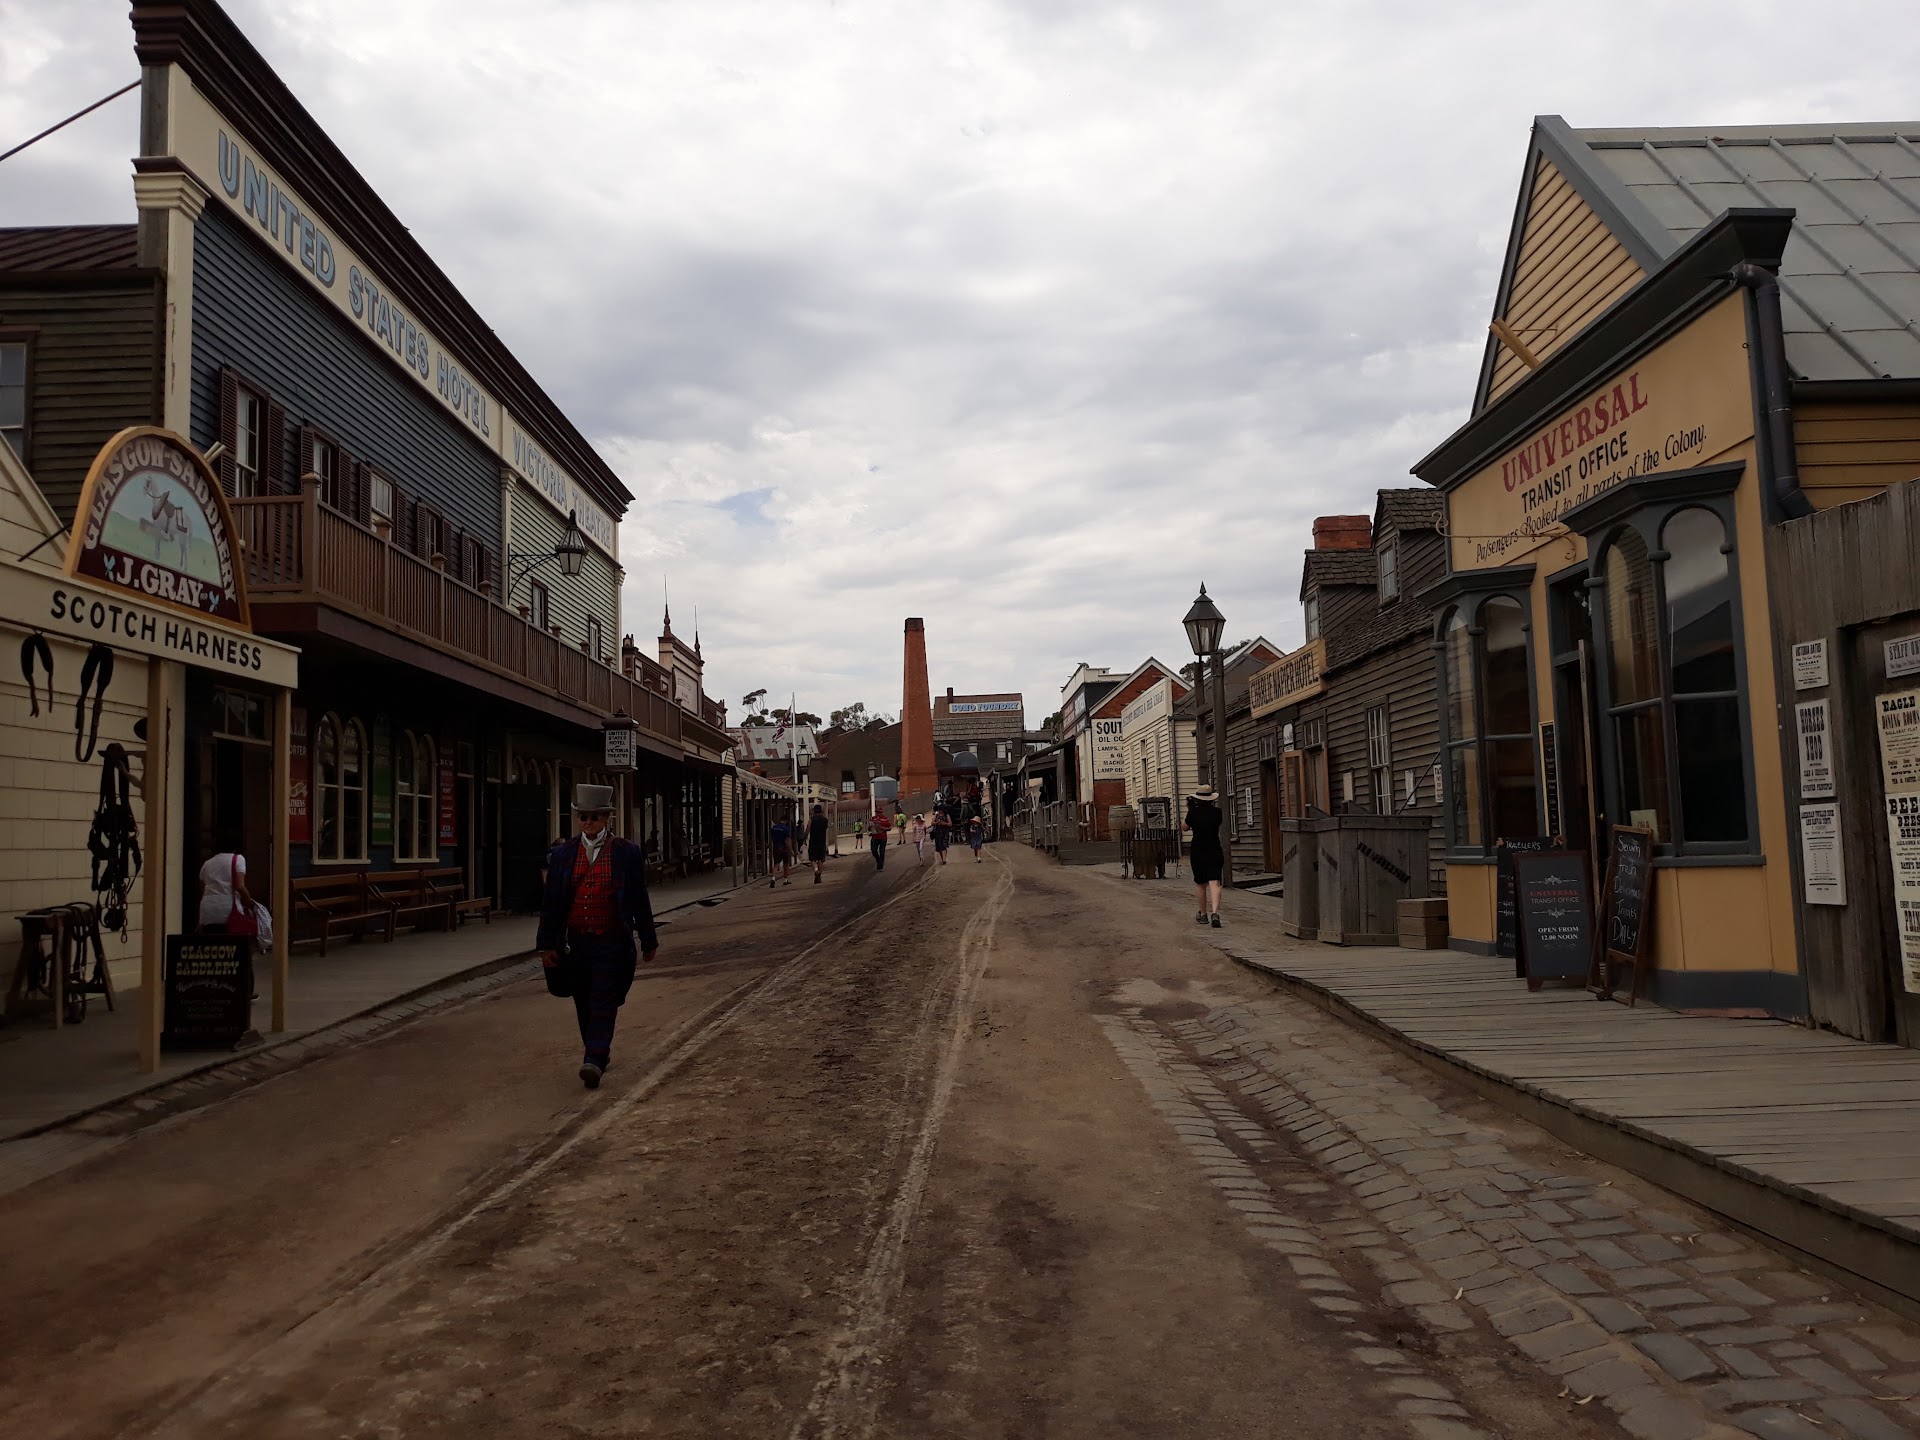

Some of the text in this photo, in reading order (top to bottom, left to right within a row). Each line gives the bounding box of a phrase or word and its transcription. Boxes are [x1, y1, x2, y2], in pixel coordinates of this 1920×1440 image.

[218, 128, 489, 438] UNITED STATES HOTEL
[1501, 372, 1649, 493] UNIVERSAL
[1521, 431, 1629, 514] TRANSIT OFFICE
[1562, 494, 1573, 512] to
[1575, 482, 1589, 504] all
[1627, 454, 1639, 478] of
[1642, 448, 1660, 474] the
[1664, 424, 1708, 461] Colony.
[512, 427, 611, 550] VICTORIA THEATRE
[84, 439, 237, 603] GLASGOW SADDLERY
[51, 590, 262, 671] SCOTCH HARNESS
[1889, 643, 1909, 661] STAFF
[977, 702, 1019, 711] FOUNDRY
[1882, 695, 1916, 712] EAGLE
[1800, 705, 1825, 734] HORSES
[1882, 713, 1901, 730] DINING
[1805, 734, 1823, 761] SHOD
[1558, 896, 1580, 904] OFFICE
[1558, 925, 1579, 933] FROM
[180, 944, 237, 960] GLASGOW
[175, 960, 240, 976] SADDLERY
